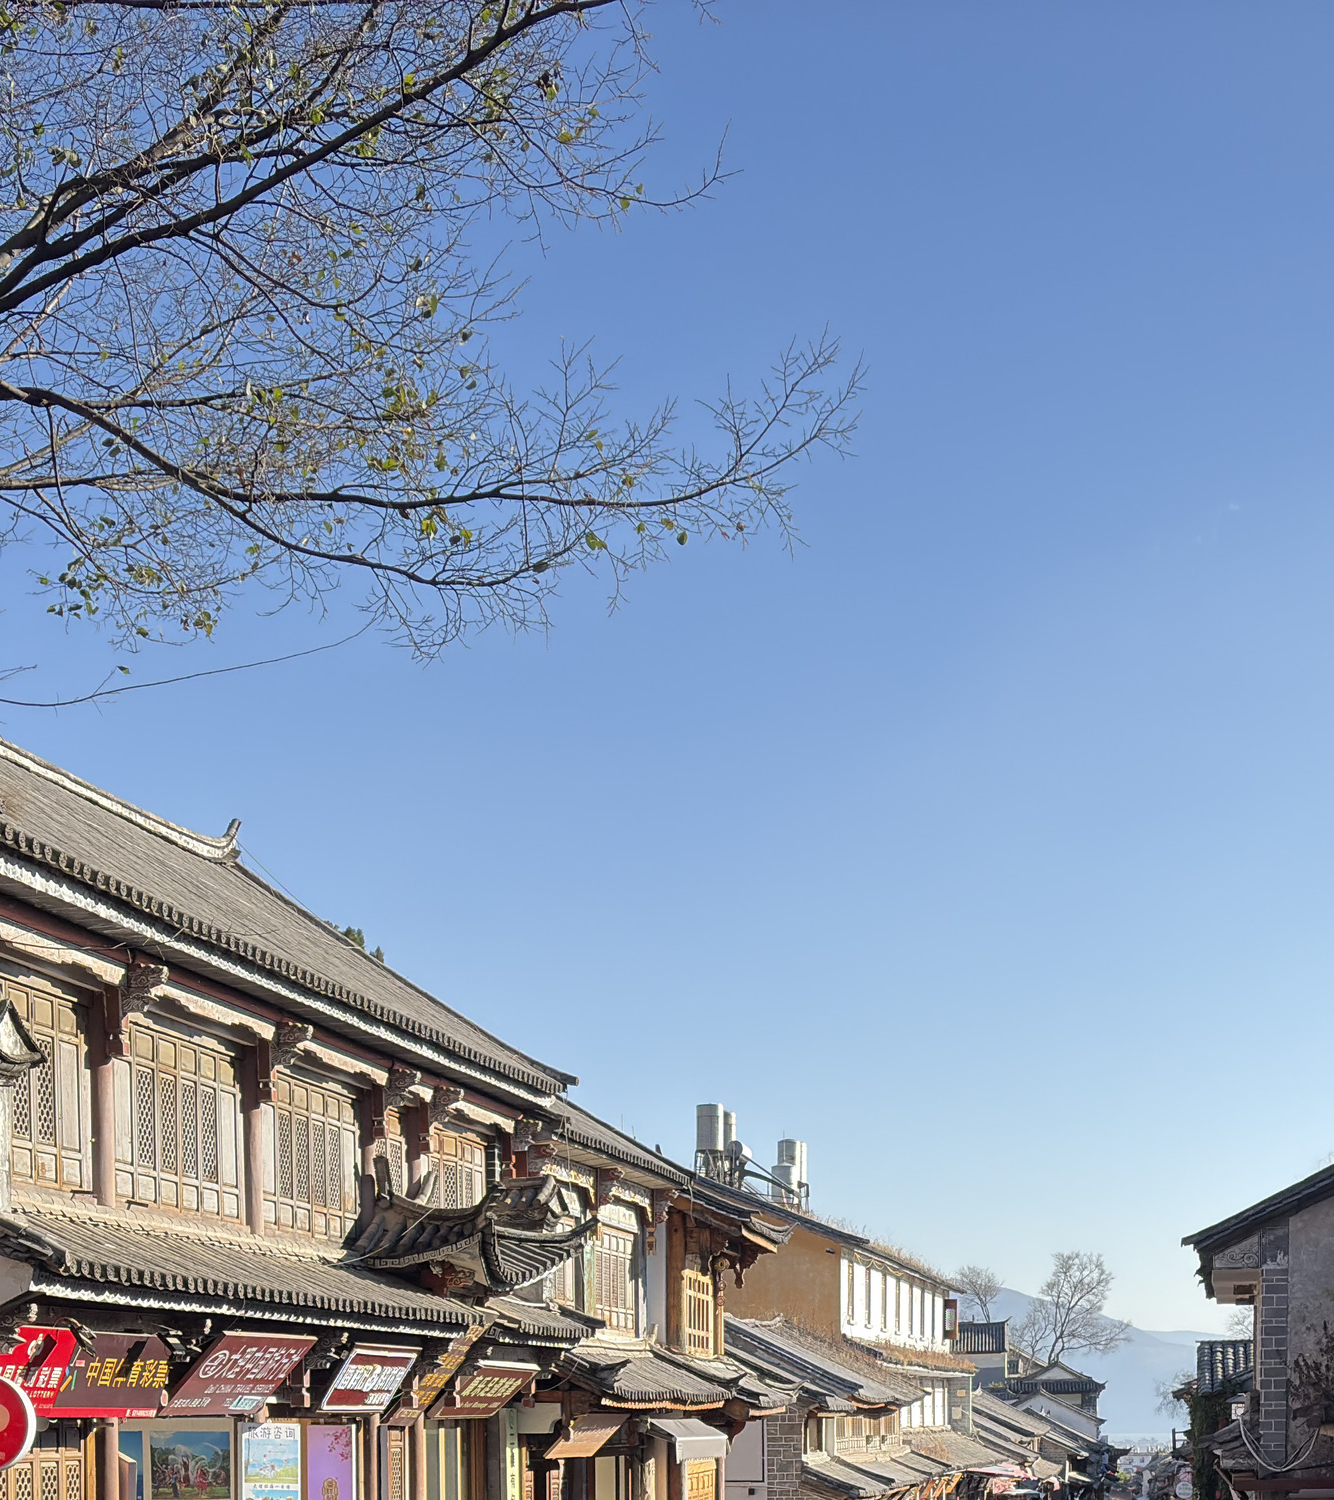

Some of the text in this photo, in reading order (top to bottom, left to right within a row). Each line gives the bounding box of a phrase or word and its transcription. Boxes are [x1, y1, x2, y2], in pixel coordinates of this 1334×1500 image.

[85, 1357, 168, 1388] 中国体育彩票
[29, 1390, 55, 1398] LOTTERY
[248, 1425, 297, 1440] 旅游咨询
